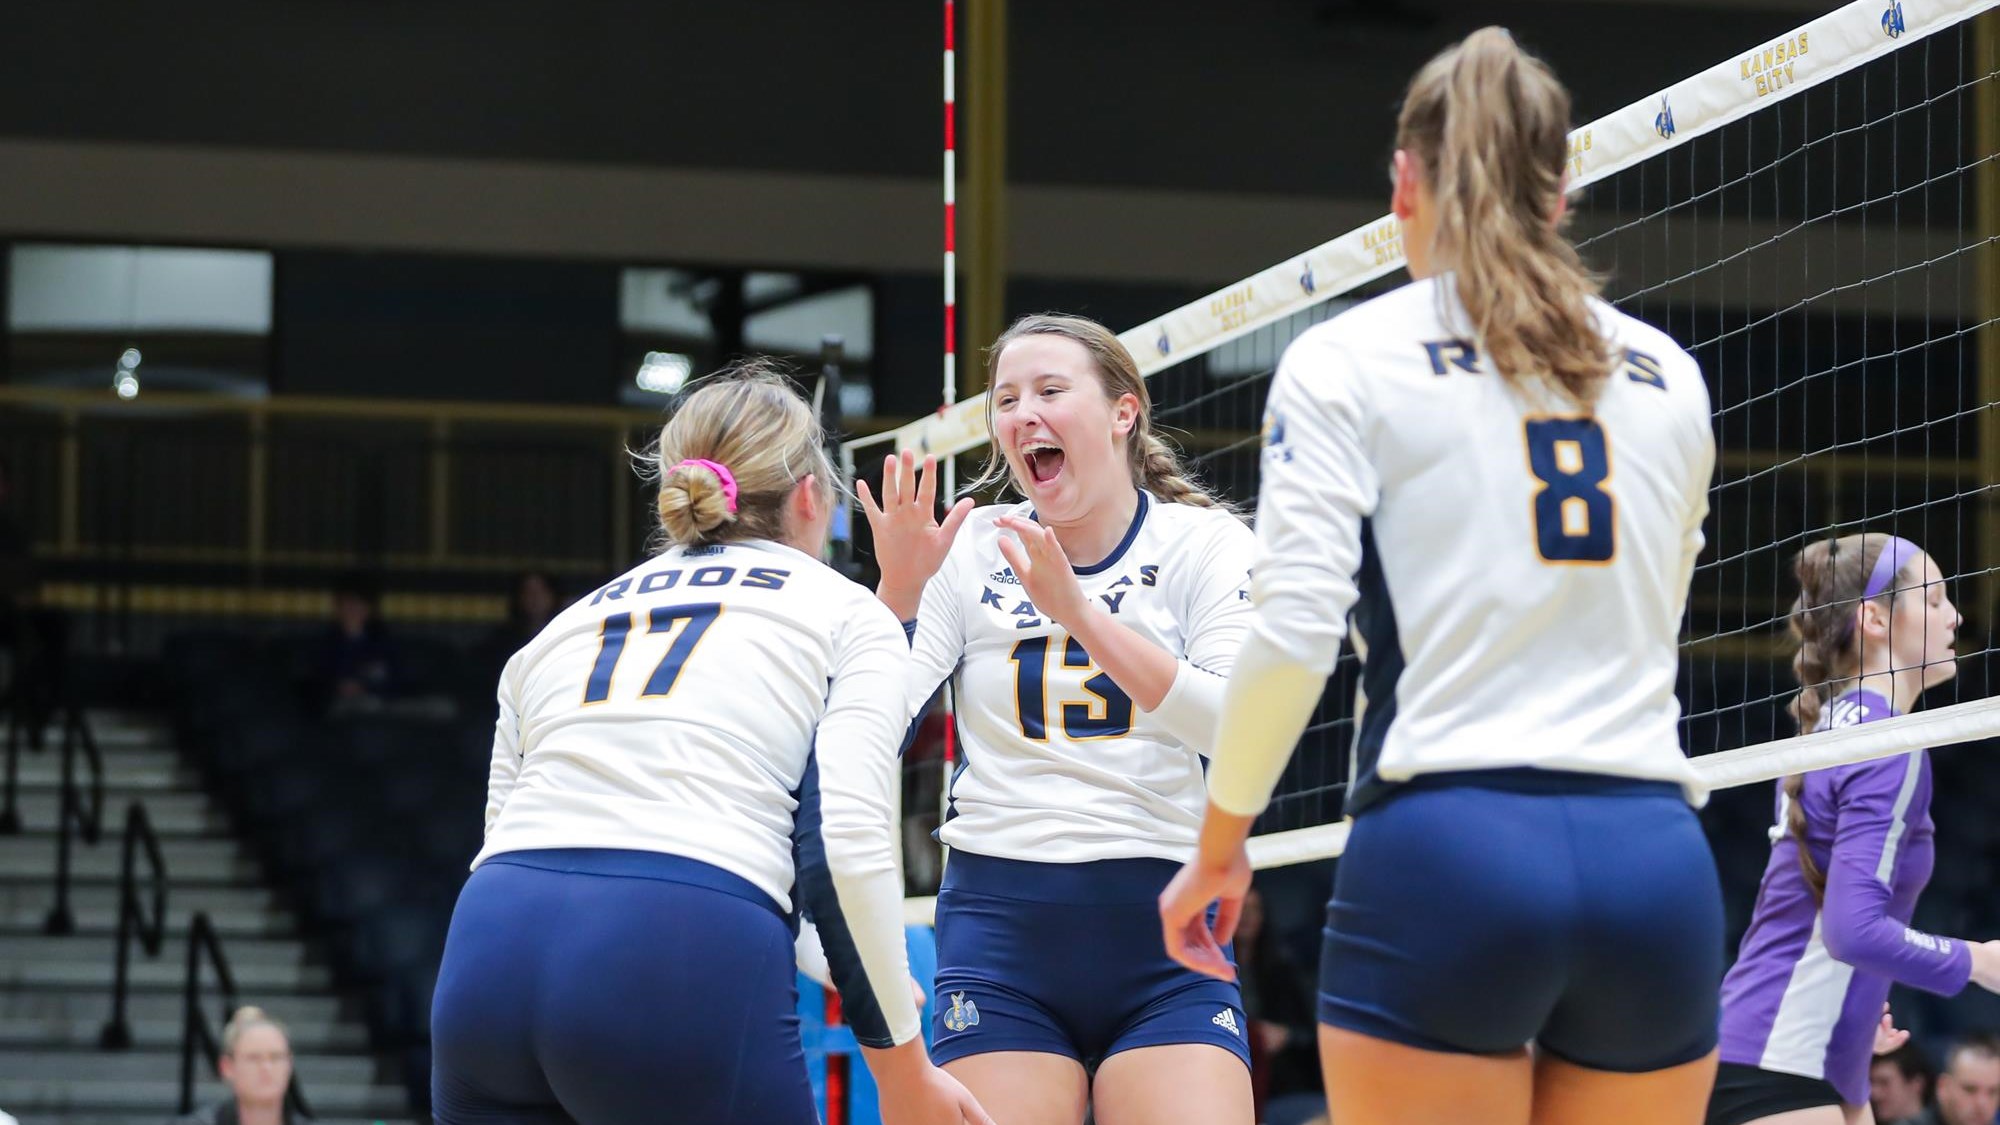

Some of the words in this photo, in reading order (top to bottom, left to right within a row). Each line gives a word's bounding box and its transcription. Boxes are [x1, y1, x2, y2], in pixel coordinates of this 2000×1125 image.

[1741, 32, 1808, 80] KANSAS
[1755, 61, 1794, 97] CITY
[1421, 338, 1668, 391] RS
[1522, 412, 1620, 567] 8
[589, 566, 791, 607] ROOS
[580, 602, 726, 707] 17
[1008, 635, 1135, 742] 13
